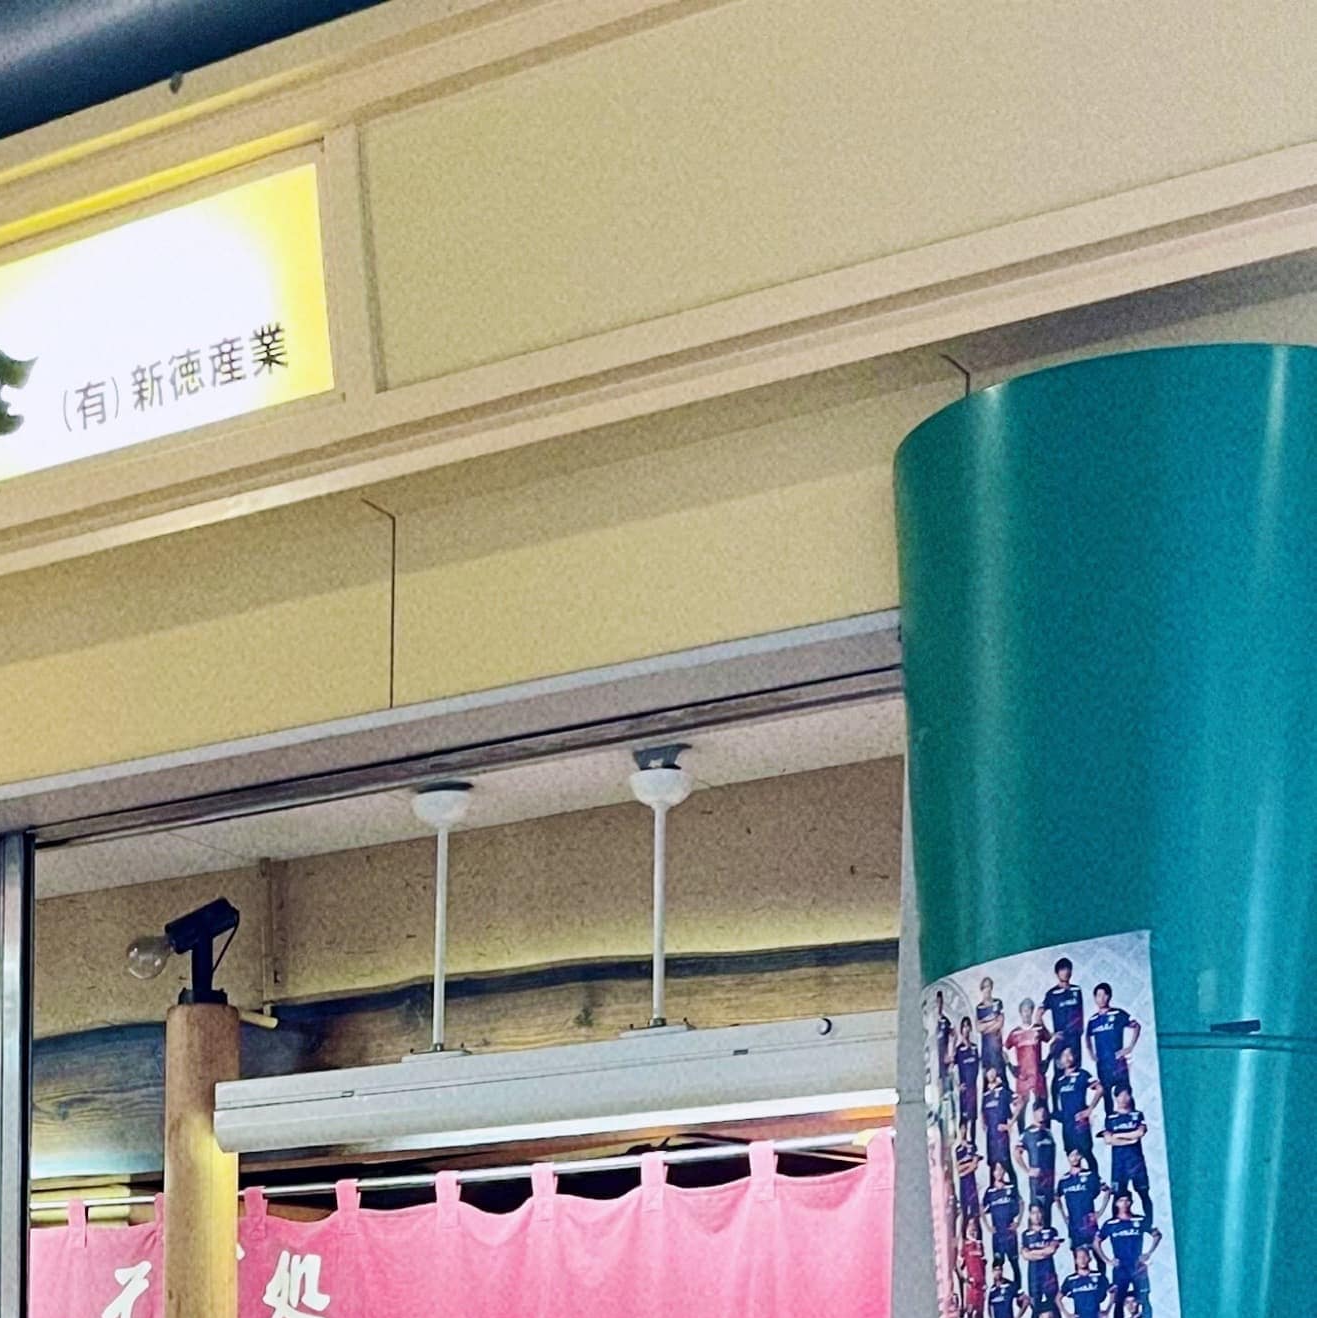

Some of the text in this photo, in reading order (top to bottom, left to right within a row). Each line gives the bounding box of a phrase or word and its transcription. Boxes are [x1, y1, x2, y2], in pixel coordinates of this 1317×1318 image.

[62, 322, 288, 432] (有)新徳産業
